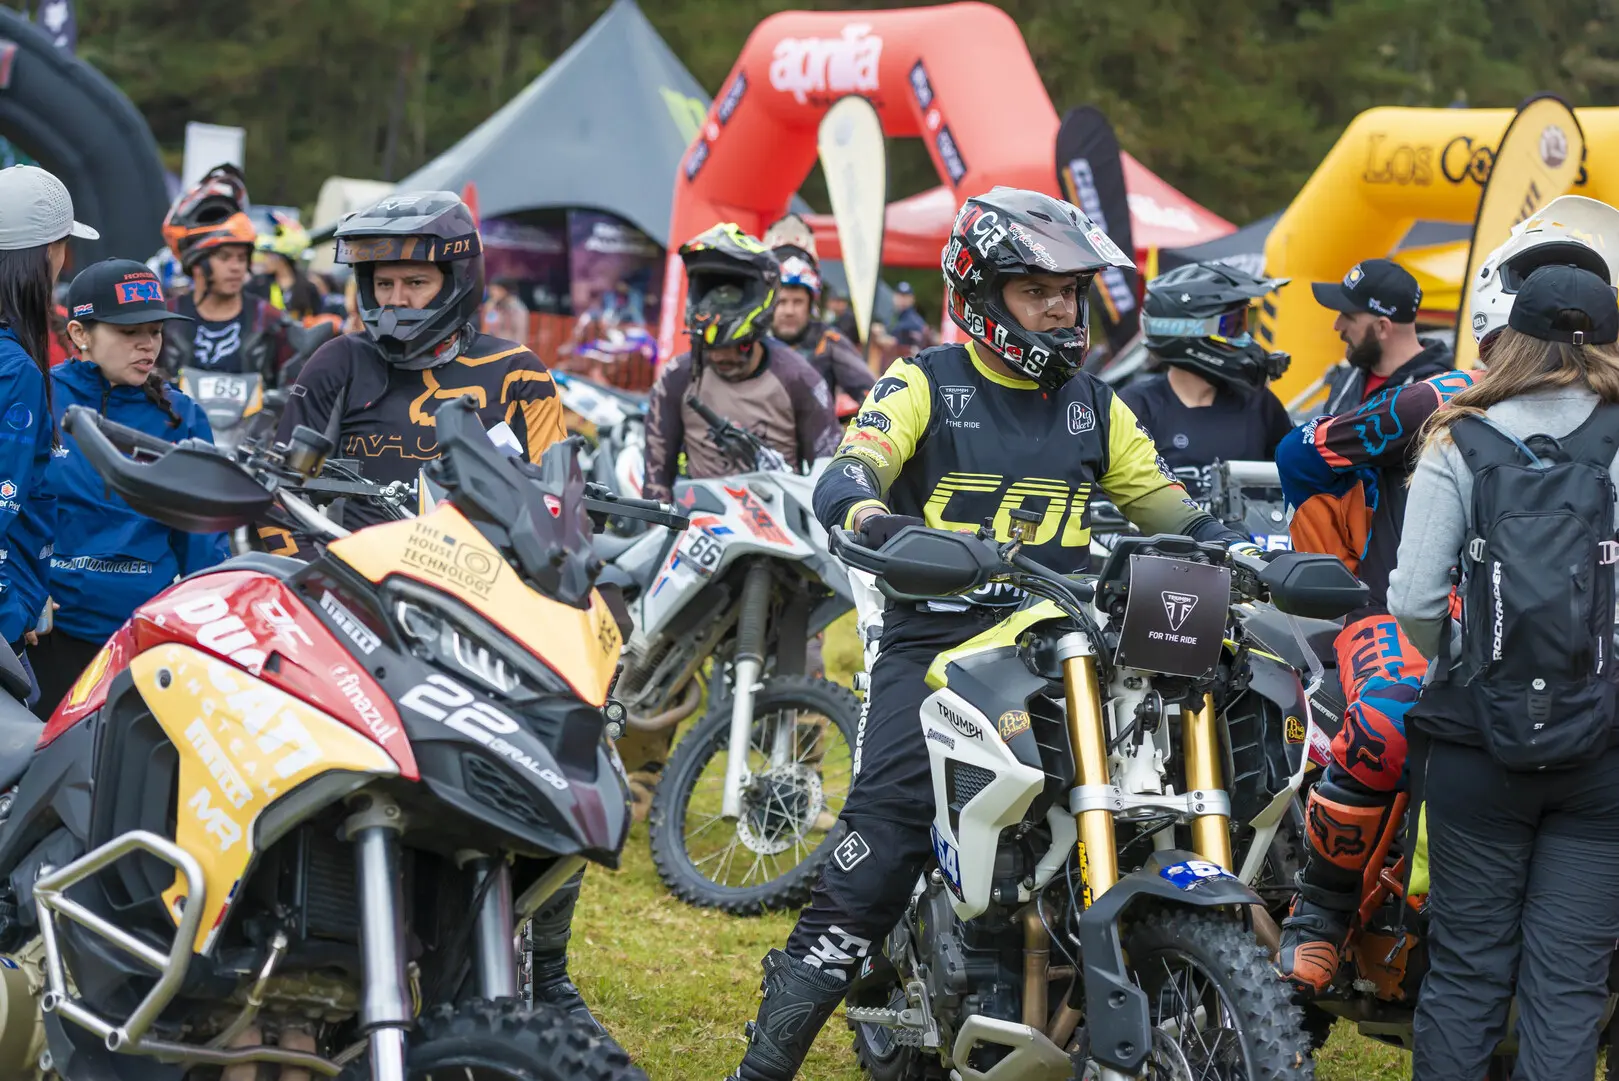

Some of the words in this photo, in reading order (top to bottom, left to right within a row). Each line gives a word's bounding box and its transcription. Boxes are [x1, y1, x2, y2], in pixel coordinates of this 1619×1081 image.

[443, 239, 470, 255] FOX
[214, 378, 240, 398] 65
[949, 420, 962, 428] THE
[963, 421, 981, 429] RIDE
[415, 522, 440, 539] THE
[408, 534, 453, 559] HOUSE
[689, 535, 722, 566] 66
[403, 547, 493, 595] TECHNOLOGY
[1167, 594, 1192, 603] TRIUMPH
[320, 589, 382, 656] PIRELLI
[1148, 630, 1164, 640] FOR
[1165, 633, 1179, 642] THE
[1180, 635, 1197, 645] RIDE
[399, 674, 520, 746] 22
[936, 701, 984, 741] TRIUMPH
[1533, 722, 1545, 730] ST
[936, 831, 959, 886] 54
